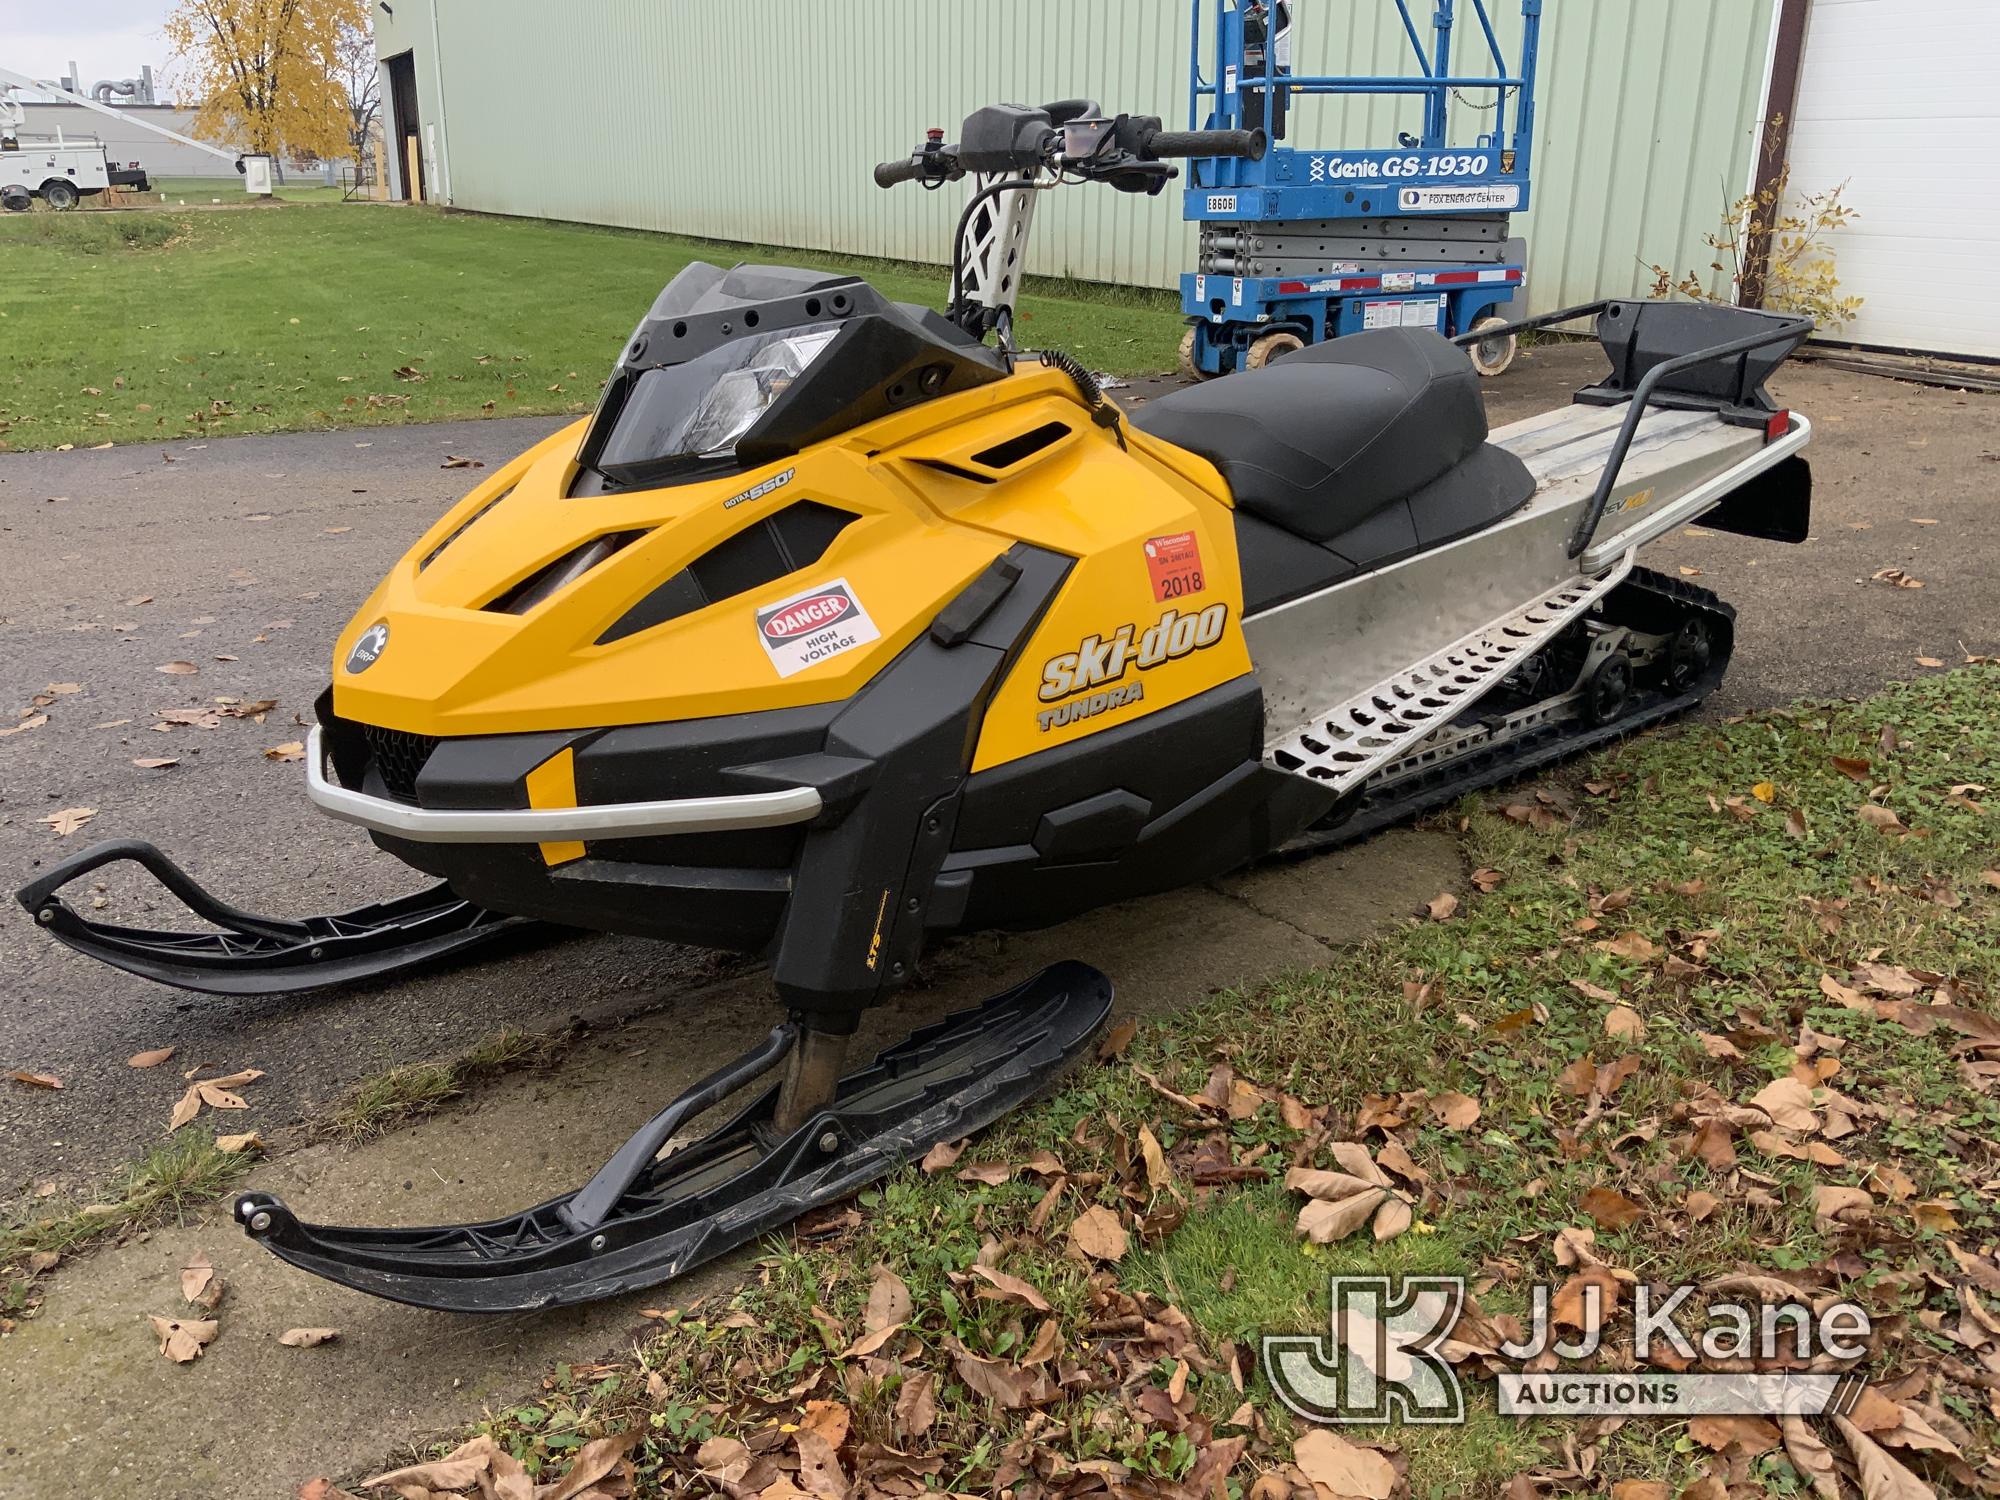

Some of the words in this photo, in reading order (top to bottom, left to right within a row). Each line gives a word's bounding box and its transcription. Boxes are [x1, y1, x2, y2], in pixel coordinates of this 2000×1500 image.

[1328, 158, 1379, 178] Genie
[1428, 195, 1444, 204] FOX
[1446, 194, 1475, 204] ENERGY
[1477, 194, 1505, 203] CENTER
[724, 492, 750, 509] ROTAX
[1155, 534, 1191, 546] Wisconsin
[1161, 572, 1202, 599] 2018
[771, 597, 845, 635] DANGER
[806, 630, 838, 649] HIGH
[356, 649, 376, 662] BRP
[800, 635, 857, 664] VOLTAGE
[1037, 680, 1144, 732] TUNDRA
